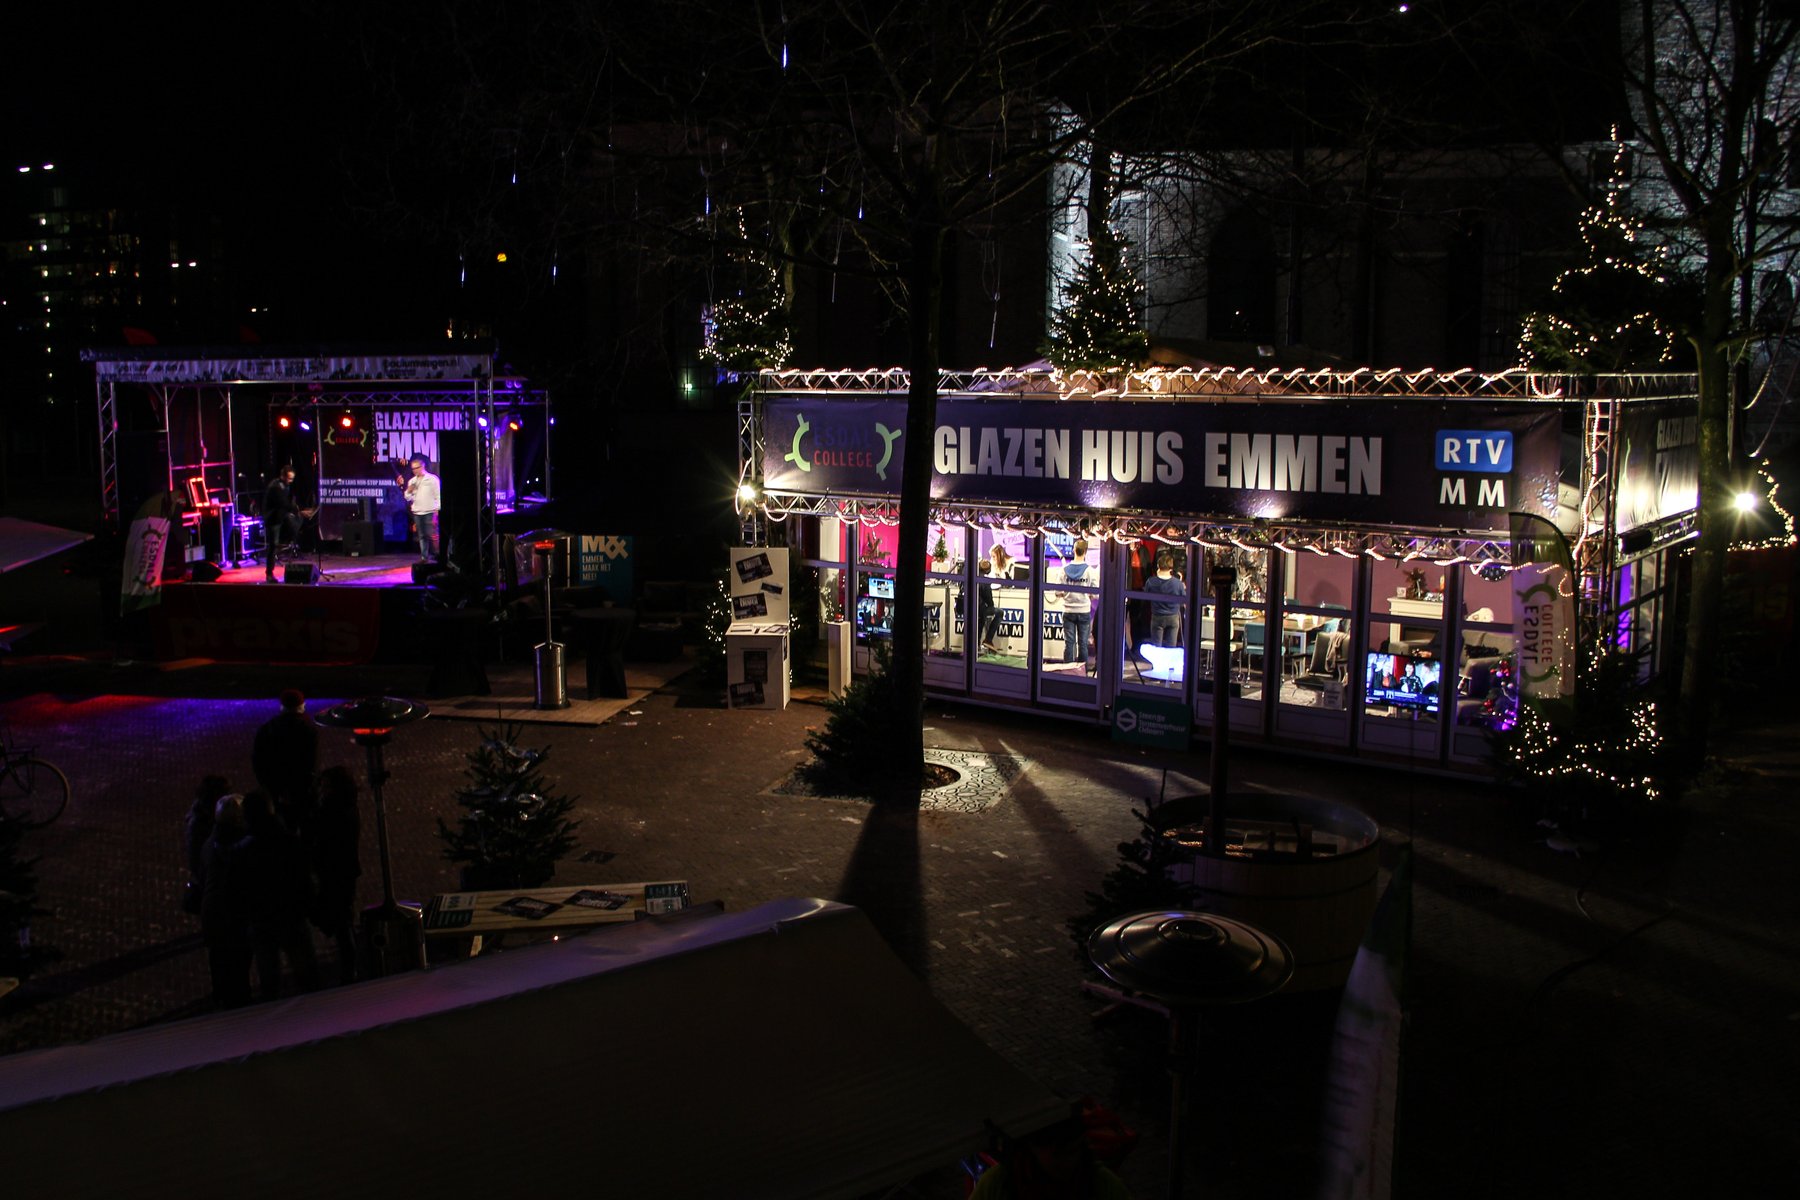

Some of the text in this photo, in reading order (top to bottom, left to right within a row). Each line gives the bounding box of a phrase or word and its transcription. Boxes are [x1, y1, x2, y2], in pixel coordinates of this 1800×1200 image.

[375, 411, 470, 430] GLAZEN HUIS
[377, 431, 439, 462] EMM
[813, 427, 872, 447] ESDAL
[813, 450, 873, 468] COLLEGE
[933, 425, 1382, 496] GLAZEN HUIS EMMEN
[1442, 437, 1506, 465] RTV
[341, 488, 349, 496] 21
[350, 488, 383, 497] DECEMBER
[168, 609, 360, 656] praxis
